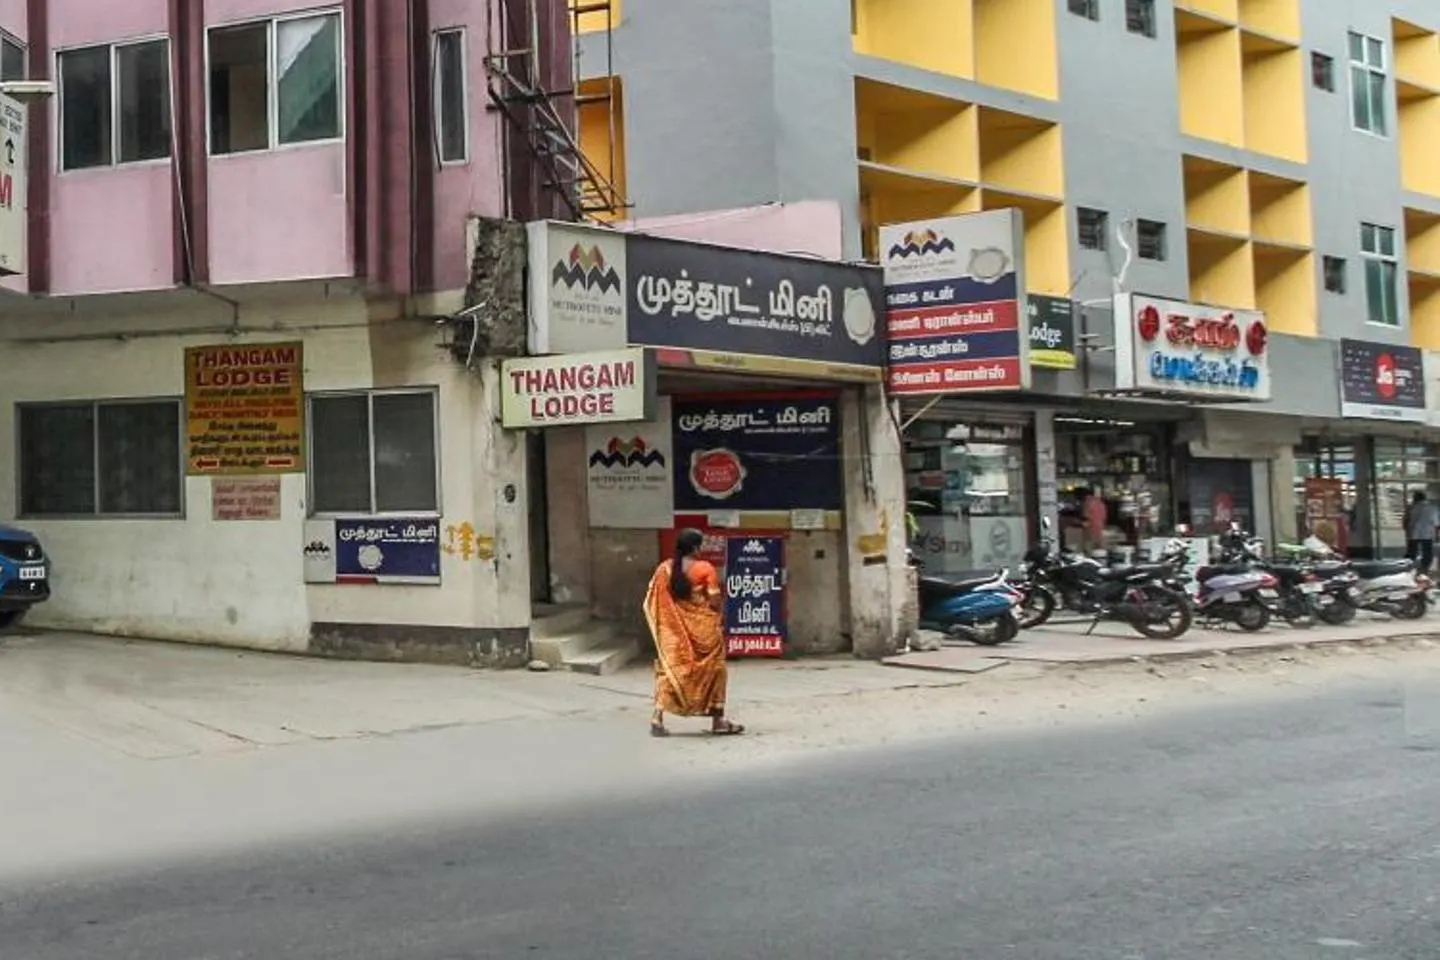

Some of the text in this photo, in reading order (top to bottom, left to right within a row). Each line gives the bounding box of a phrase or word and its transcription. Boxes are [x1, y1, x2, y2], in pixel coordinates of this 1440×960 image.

[636, 268, 833, 322] முத்தூட் மினி
[193, 347, 295, 367] THANGAM
[195, 367, 290, 387] LODGE
[510, 361, 635, 395] THANGAM
[530, 392, 614, 421] LODGE
[678, 408, 770, 432] முத்தூட்
[775, 405, 832, 425] மினி
[339, 523, 438, 541] முத்தூட் மினி
[727, 566, 783, 598] முத்தூட்
[738, 600, 771, 623] மினி
